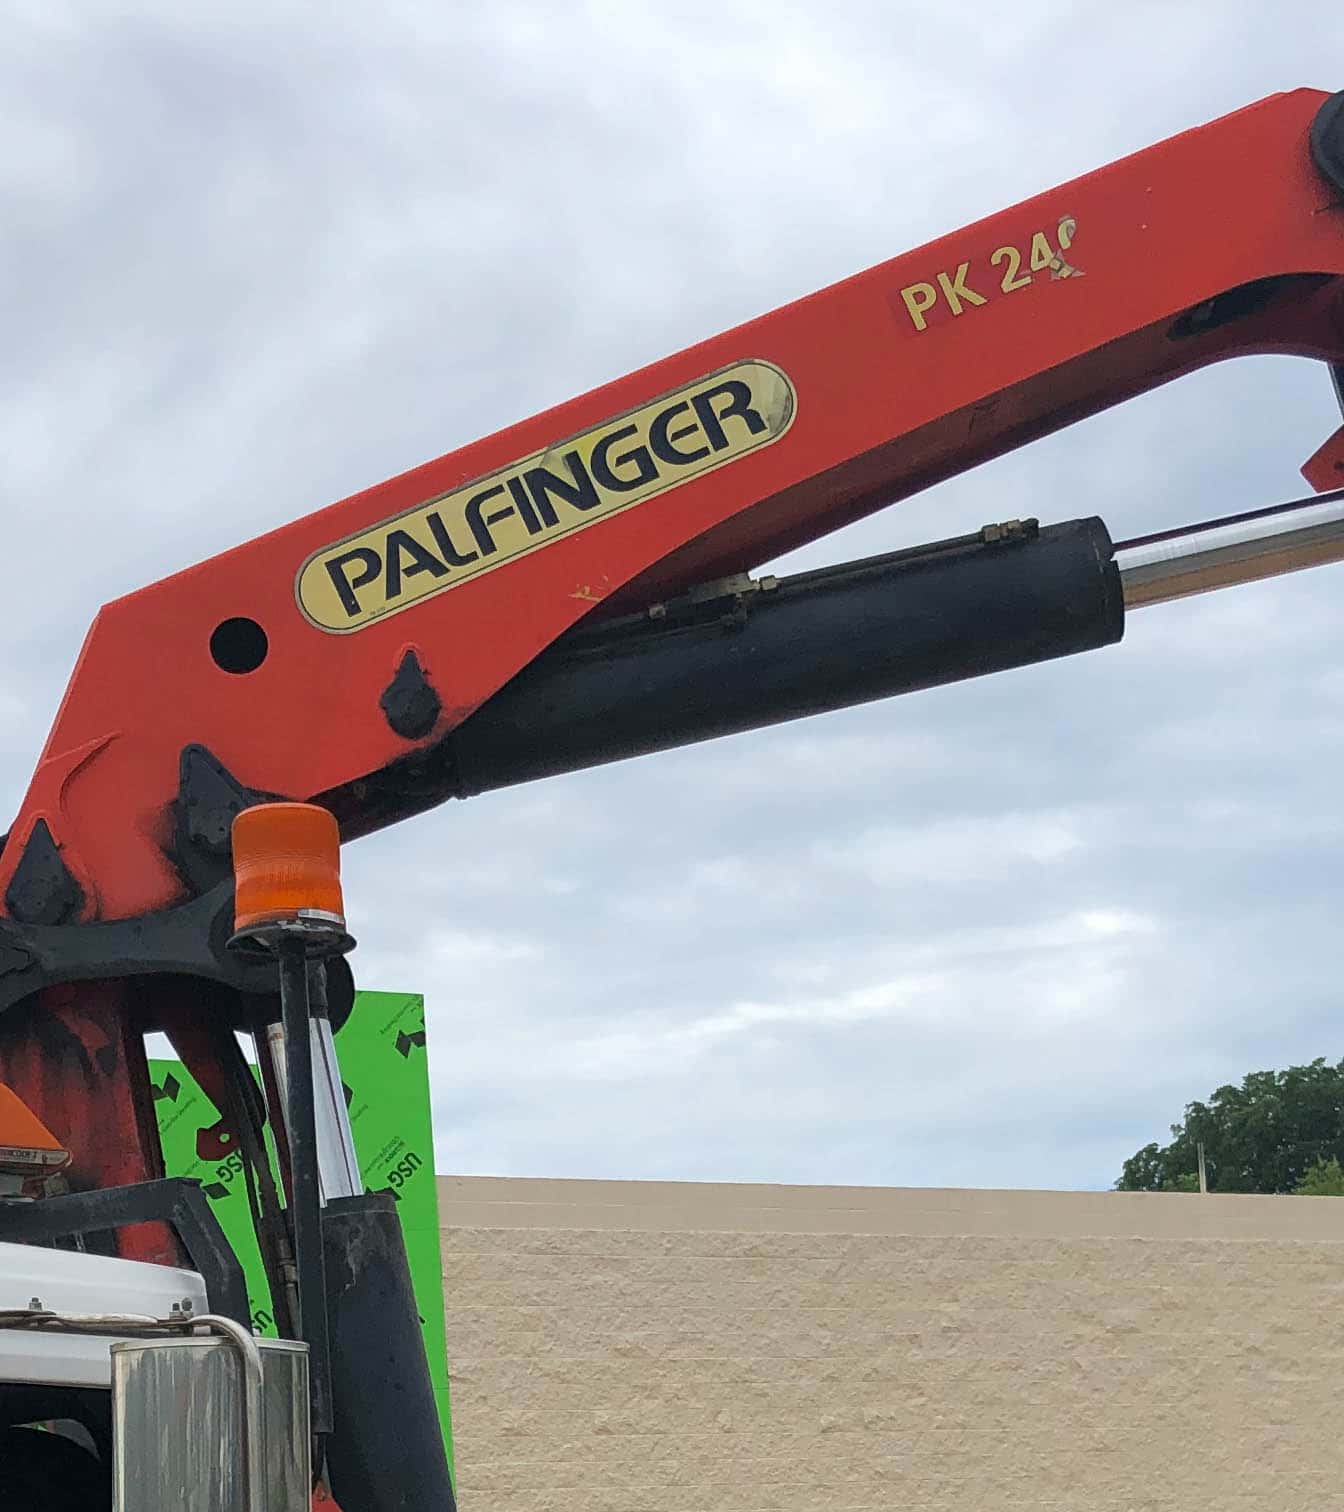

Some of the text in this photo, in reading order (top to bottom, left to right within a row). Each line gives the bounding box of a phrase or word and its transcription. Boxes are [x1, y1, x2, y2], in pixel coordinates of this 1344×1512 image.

[900, 262, 988, 332] PK
[324, 379, 770, 619] PALFINGER
[215, 1150, 244, 1183] SG
[386, 1152, 423, 1188] USG
